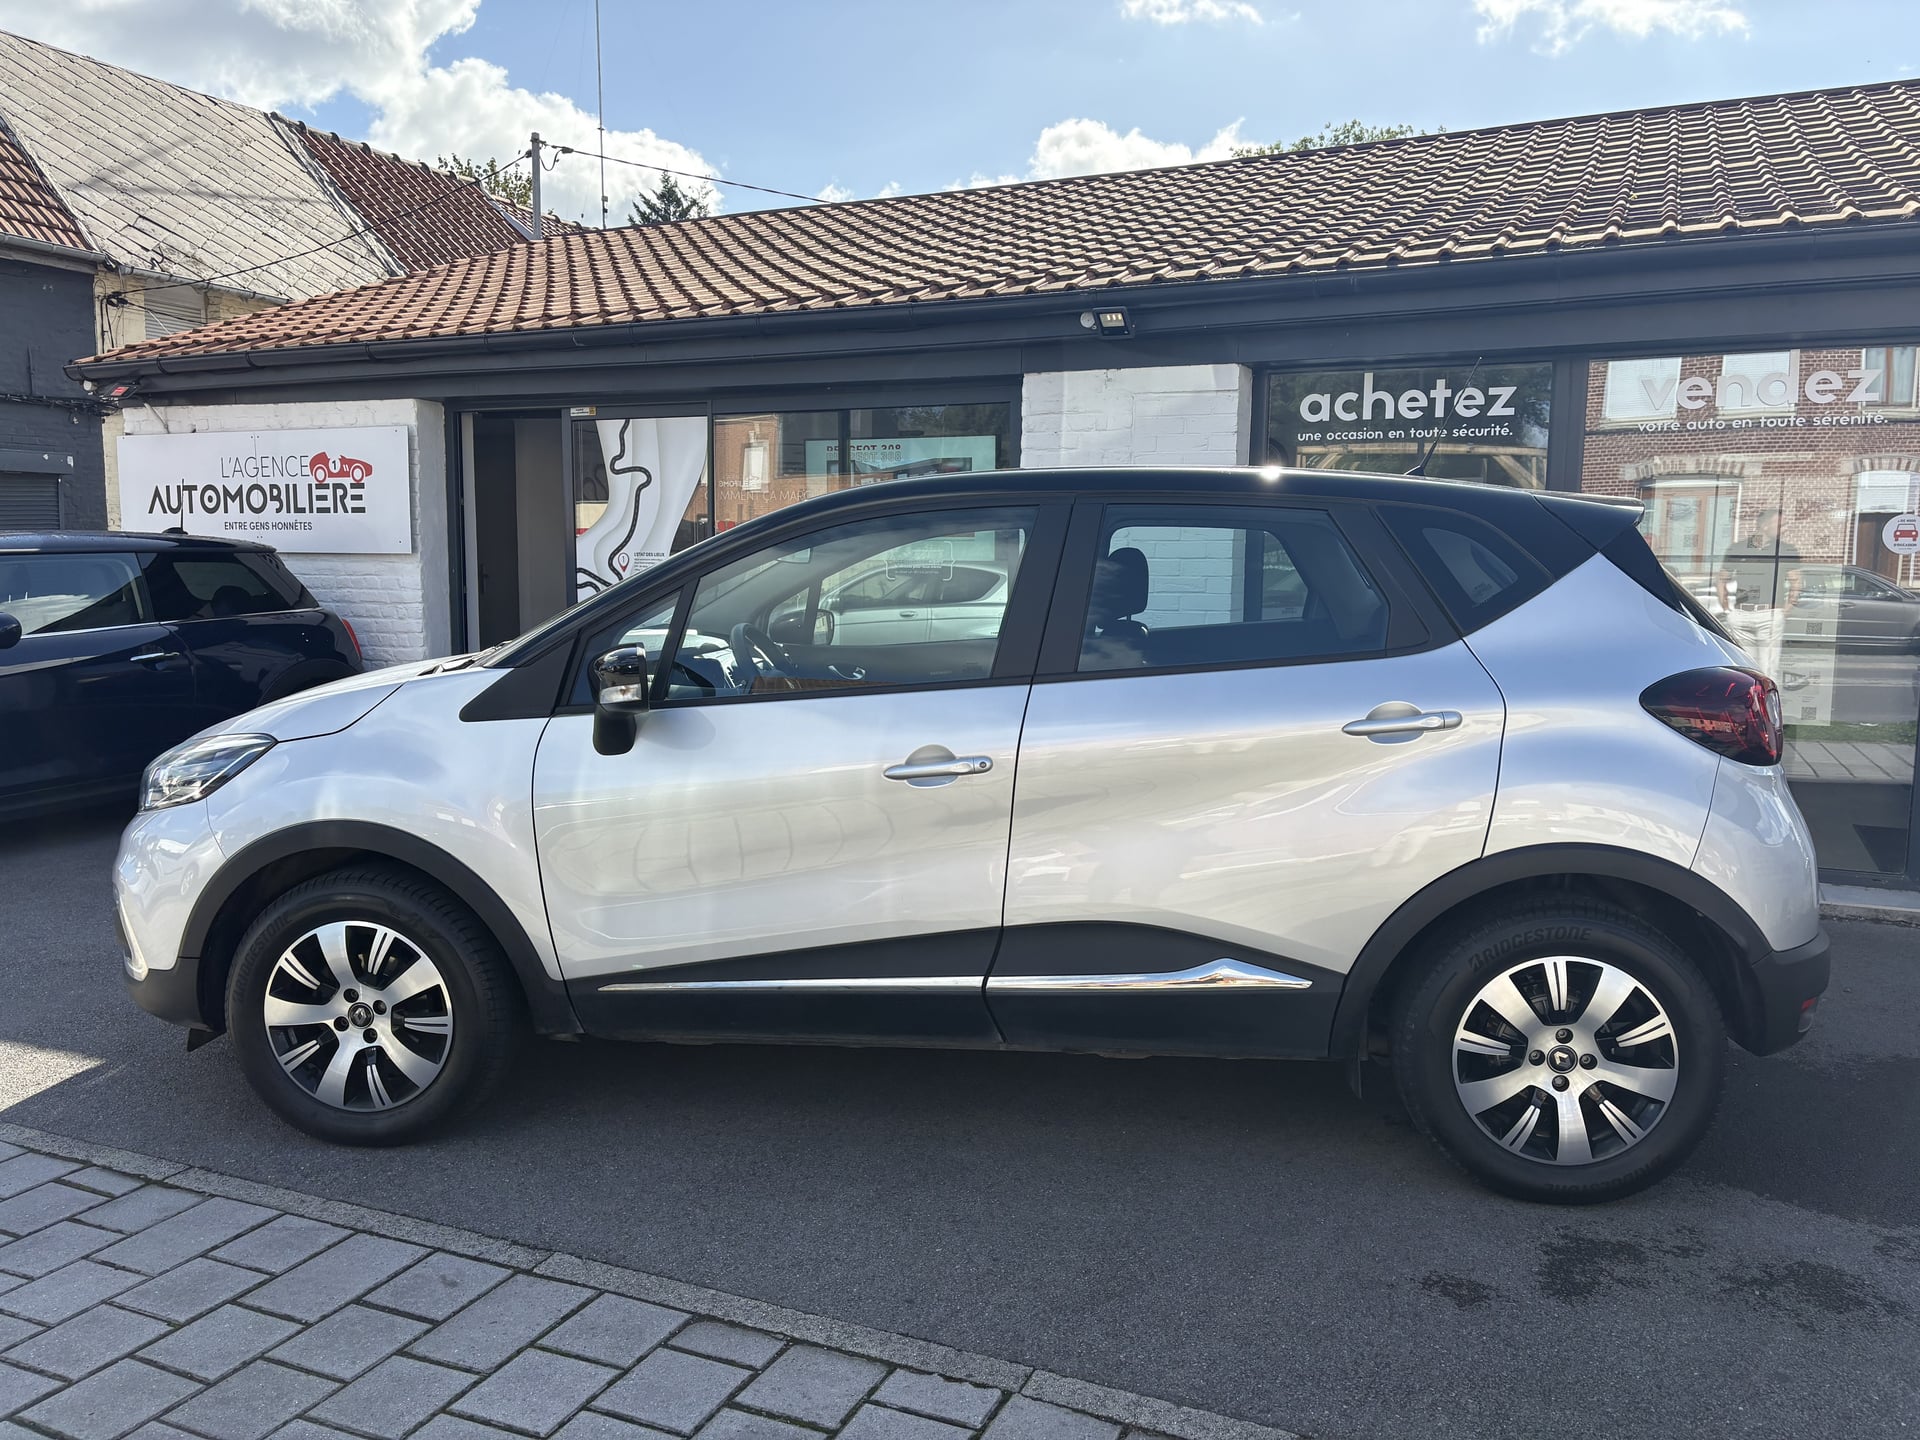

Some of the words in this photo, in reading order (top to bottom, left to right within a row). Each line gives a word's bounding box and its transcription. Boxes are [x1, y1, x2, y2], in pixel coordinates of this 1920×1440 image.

[1641, 349, 1883, 410] vendez
[1300, 372, 1518, 422] achetez
[1297, 430, 1322, 441] une
[1326, 427, 1383, 440] occasion
[1388, 428, 1405, 439] en
[1409, 426, 1448, 438] toute
[1452, 422, 1513, 438] sécurité.
[1638, 420, 1680, 432] votre
[1687, 418, 1725, 431] auto
[1732, 418, 1752, 429] en
[1759, 415, 1806, 428] toute
[1812, 410, 1888, 426] sérénité.
[220, 455, 310, 478] L'AGENCE
[224, 521, 248, 531] ENTRE
[249, 521, 270, 531] GENS
[271, 519, 313, 531] HONNÊTES
[1467, 926, 1592, 972] BRIDGESTONE
